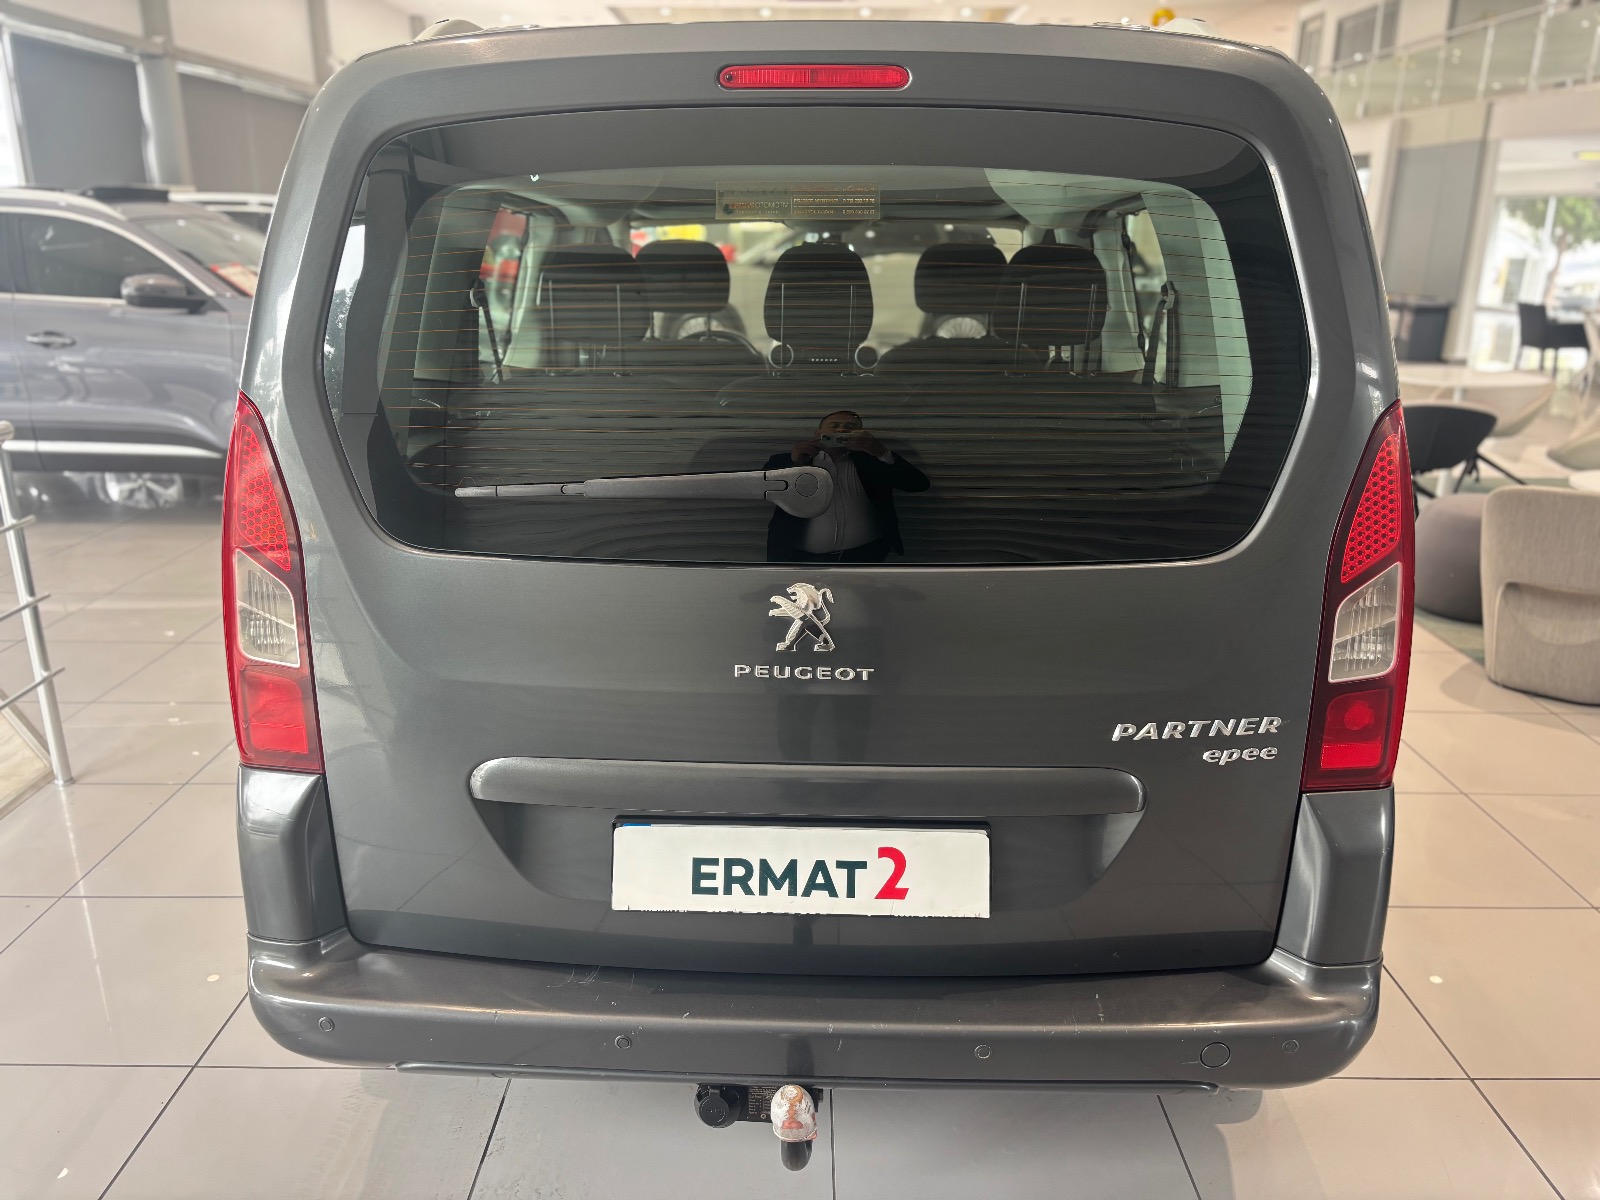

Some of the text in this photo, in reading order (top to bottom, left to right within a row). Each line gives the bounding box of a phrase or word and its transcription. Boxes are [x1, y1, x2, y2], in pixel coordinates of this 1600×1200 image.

[734, 664, 875, 681] PEUGEOT
[1111, 716, 1282, 742] PARTNER
[1202, 746, 1278, 766] epee
